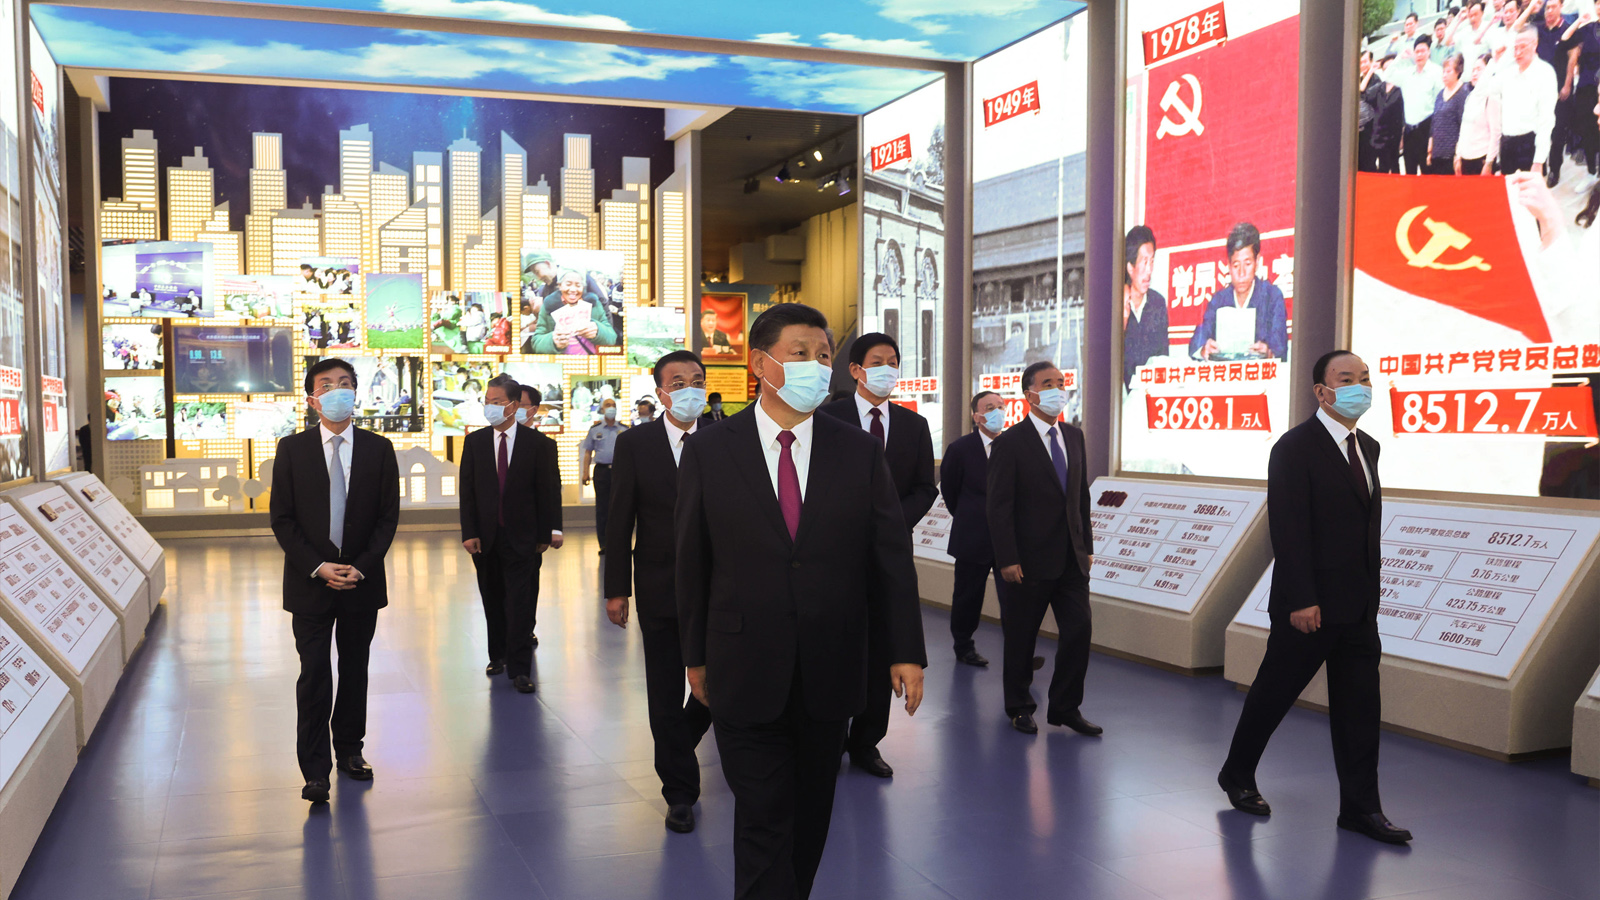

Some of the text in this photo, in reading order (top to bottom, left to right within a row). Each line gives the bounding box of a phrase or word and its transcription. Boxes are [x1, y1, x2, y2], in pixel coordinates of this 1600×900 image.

[1149, 10, 1222, 61] 1978年
[986, 85, 1036, 125] 1949年
[873, 139, 907, 168] 1921年
[1171, 253, 1294, 309] 党员室
[1140, 362, 1277, 384] 中国共产党党员总数
[1379, 343, 1600, 376] 中国共产党党员总数
[1154, 397, 1262, 429] 3698.1万人
[1401, 391, 1578, 433] 8512.7万人
[1399, 525, 1549, 550] 中国共产党党员总数 8512.7万人
[1485, 557, 1523, 569] 铁路里程
[1465, 588, 1503, 600] 公路里程
[1438, 631, 1483, 648] 1600万辆
[1450, 619, 1487, 633] 汽车产业
